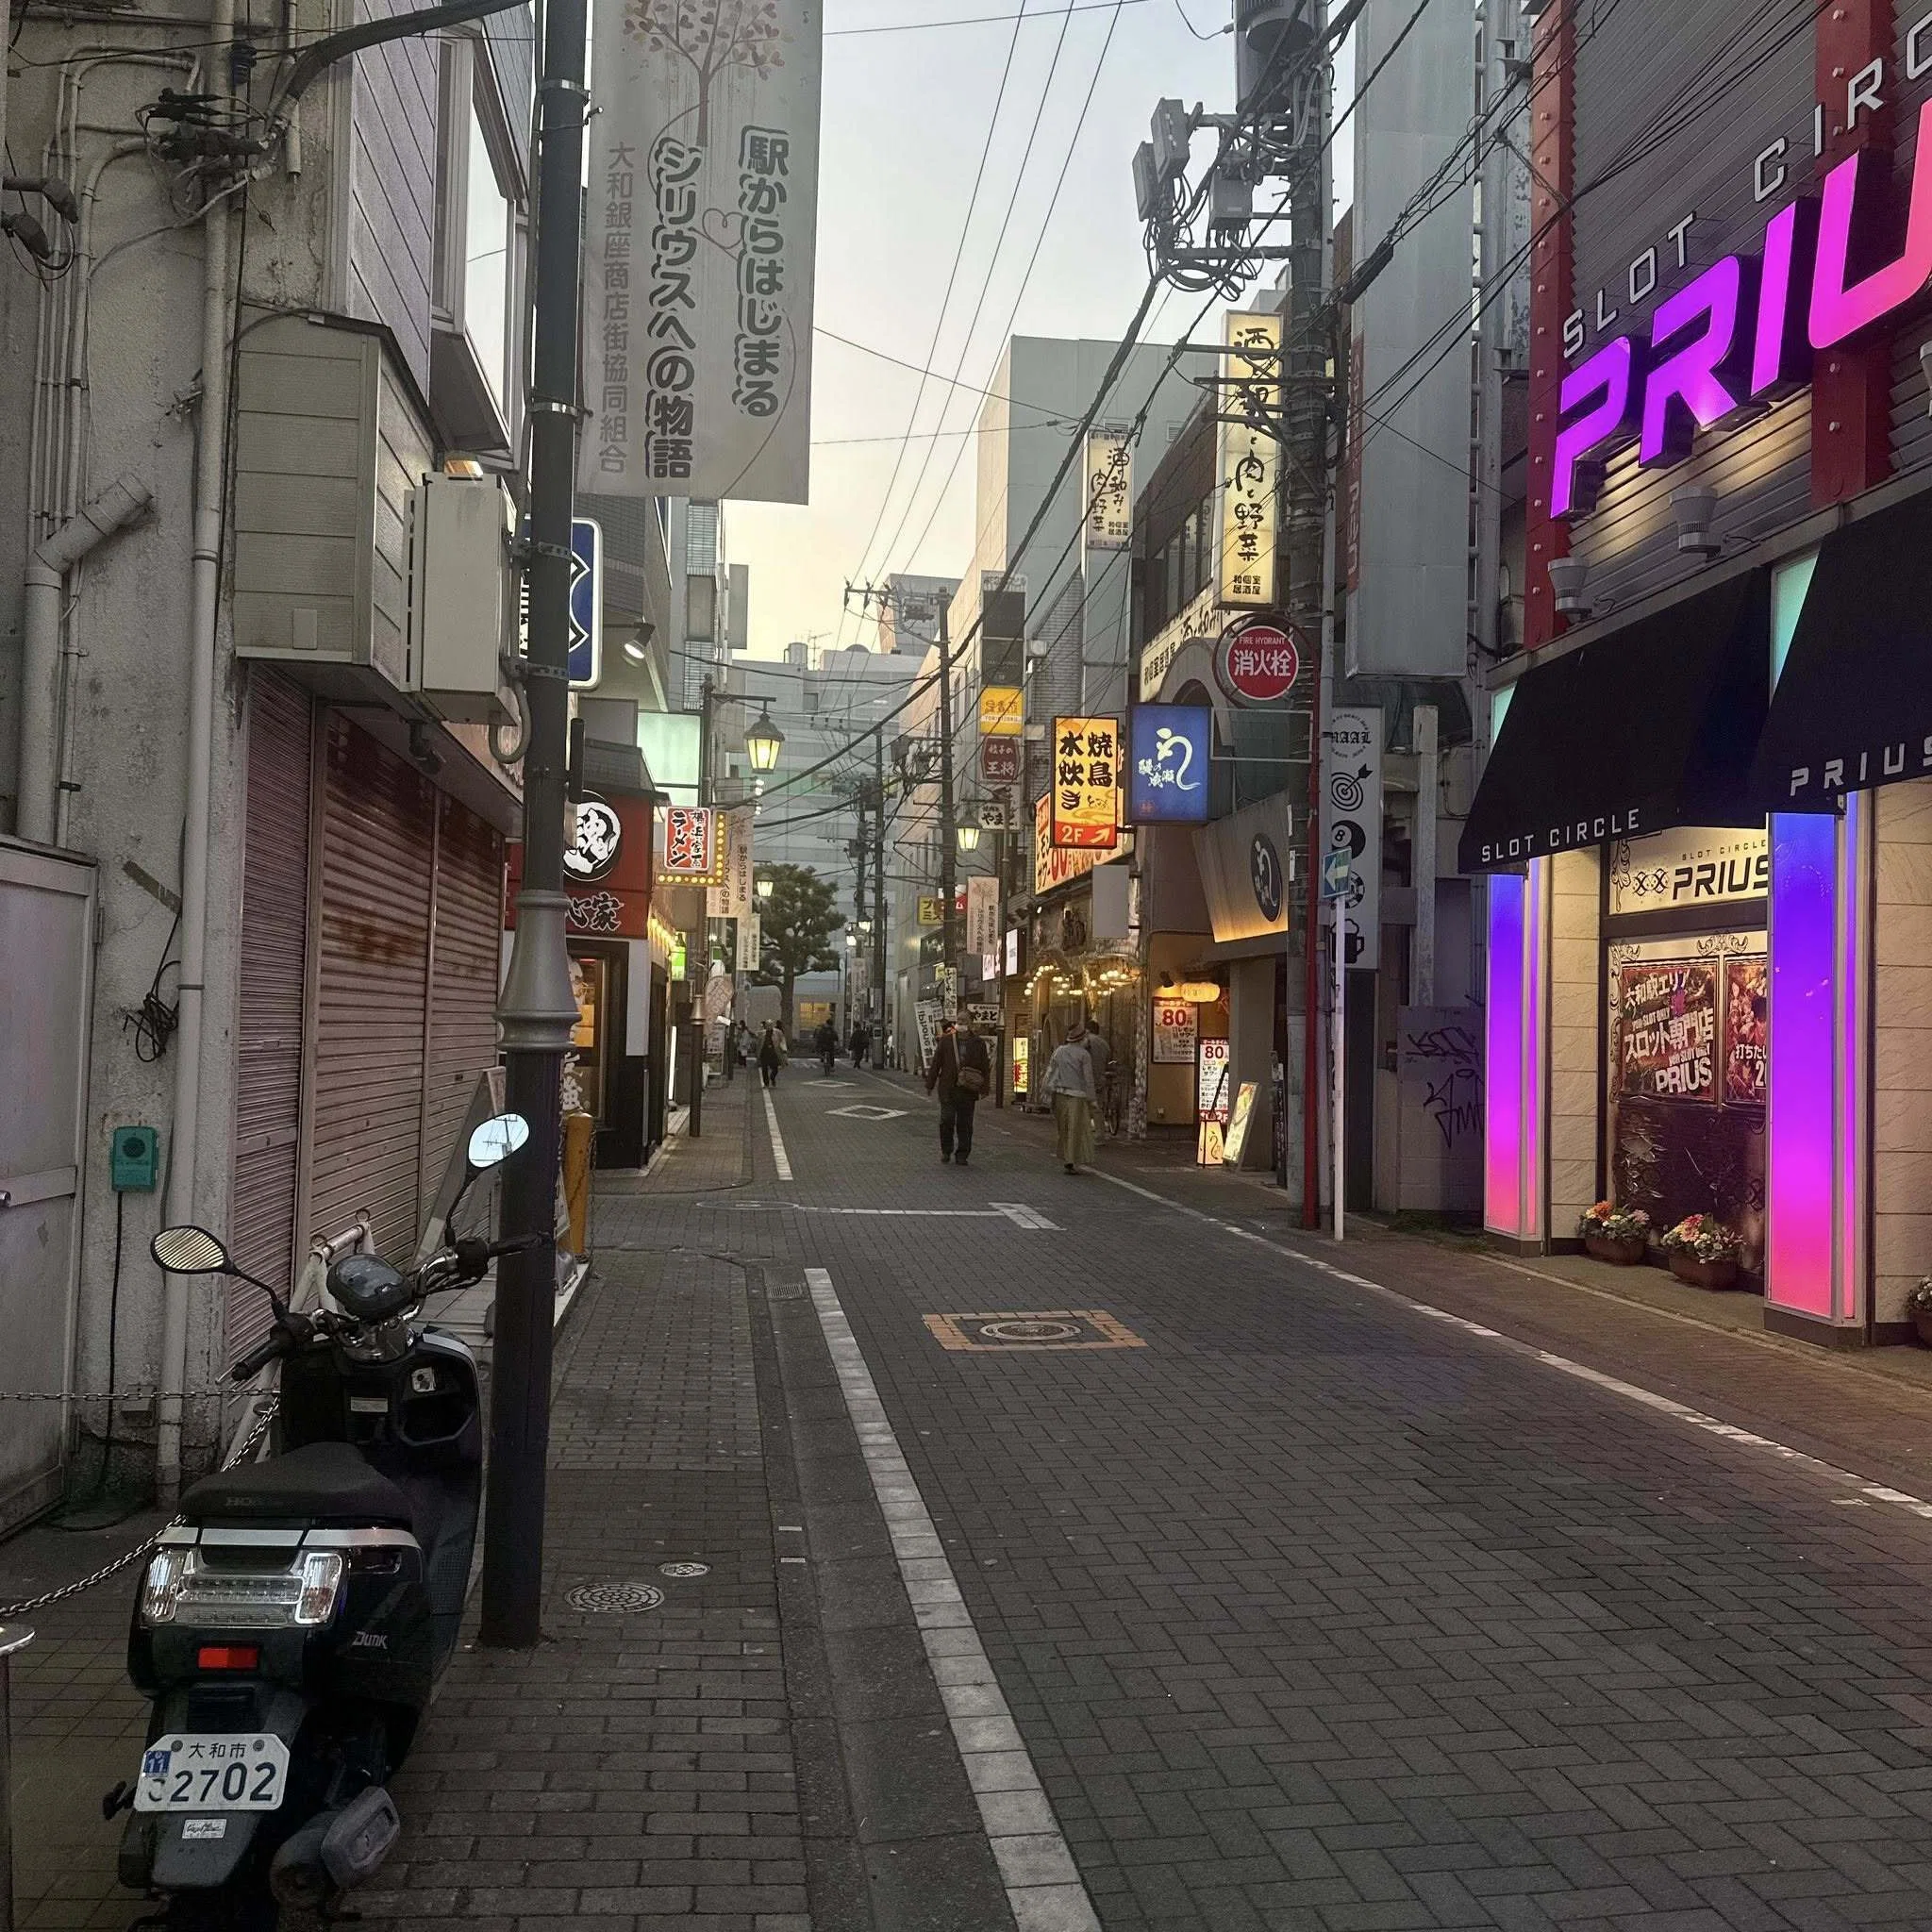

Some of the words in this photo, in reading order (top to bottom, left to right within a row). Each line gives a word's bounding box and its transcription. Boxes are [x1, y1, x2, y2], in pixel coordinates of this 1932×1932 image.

[740, 127, 791, 418] 駅からはじまる
[1563, 211, 1695, 360] SLOT
[599, 142, 636, 475] 大和銀座商店街協同組合
[651, 140, 703, 479] シリウスへの物語
[1233, 575, 1261, 585] 和個室
[1233, 585, 1261, 595] 居酒屋
[1233, 648, 1292, 677] 消火栓
[1239, 636, 1254, 645] FIRE
[1255, 636, 1286, 645] HYDRANT
[986, 761, 1015, 776] 王将
[1058, 730, 1086, 810] 水炊き
[1087, 731, 1113, 788] 焼鳥
[669, 810, 688, 866] ラーメン
[1061, 825, 1084, 844] 2F
[1482, 834, 1534, 862] SLOT
[1549, 808, 1640, 847] CIRCLE
[1682, 849, 1712, 860] SLOT
[1720, 840, 1767, 855] CIRCLE
[1673, 854, 1769, 900] PRIUS
[1624, 1007, 1714, 1063] スロット専門店
[1655, 1056, 1713, 1093] PRIUS
[188, 1742, 247, 1759] 大和市
[170, 1761, 277, 1803] 2702
